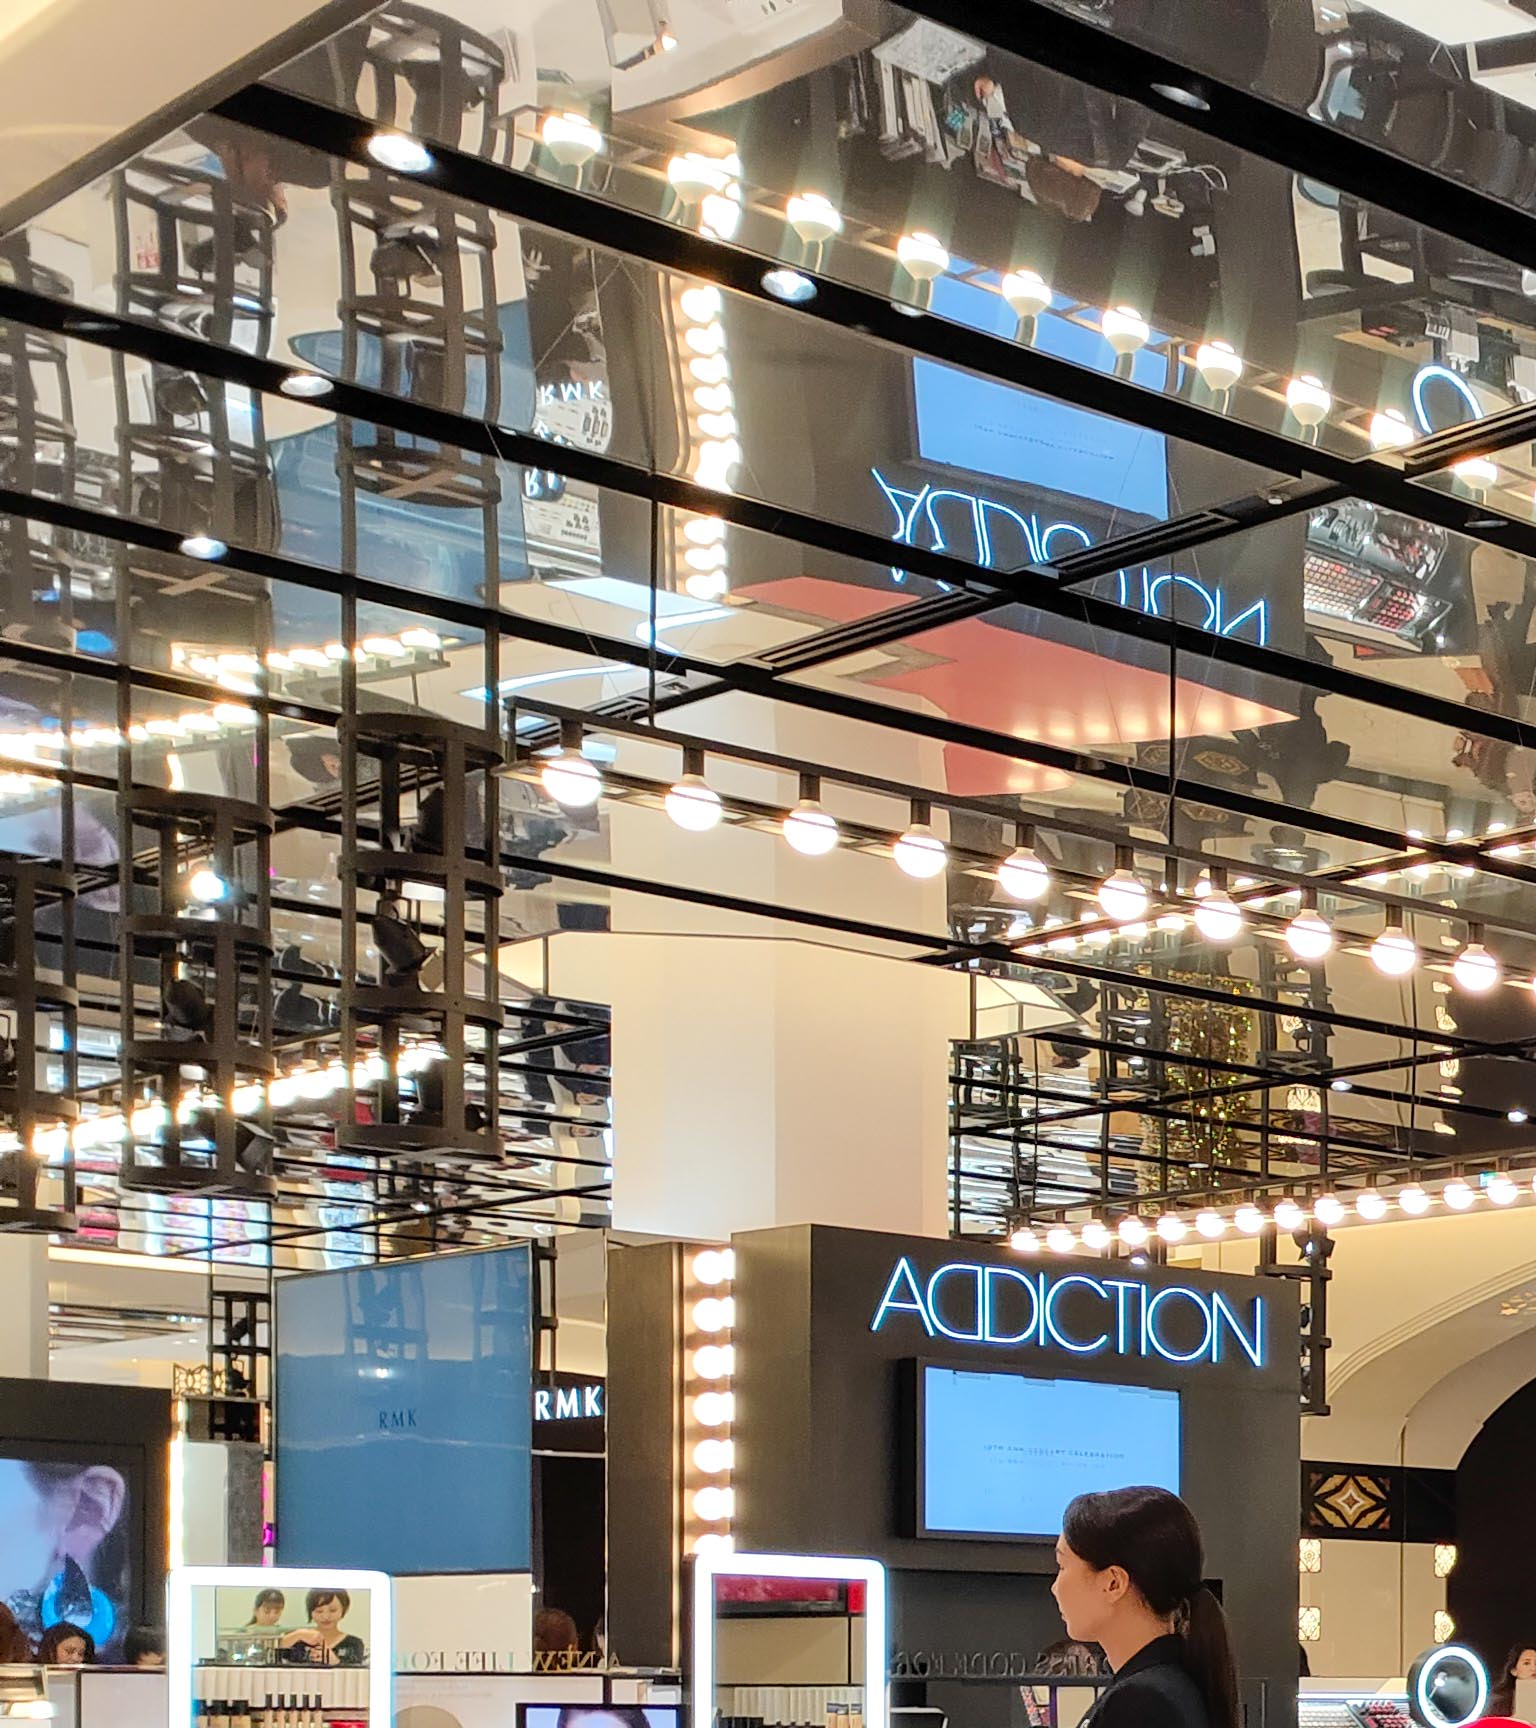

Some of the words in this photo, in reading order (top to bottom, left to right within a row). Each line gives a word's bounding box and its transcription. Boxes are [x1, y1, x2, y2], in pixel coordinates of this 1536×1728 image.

[871, 1257, 1264, 1367] ADDICTION
[379, 1408, 418, 1430] RMK
[534, 1384, 603, 1421] RMK
